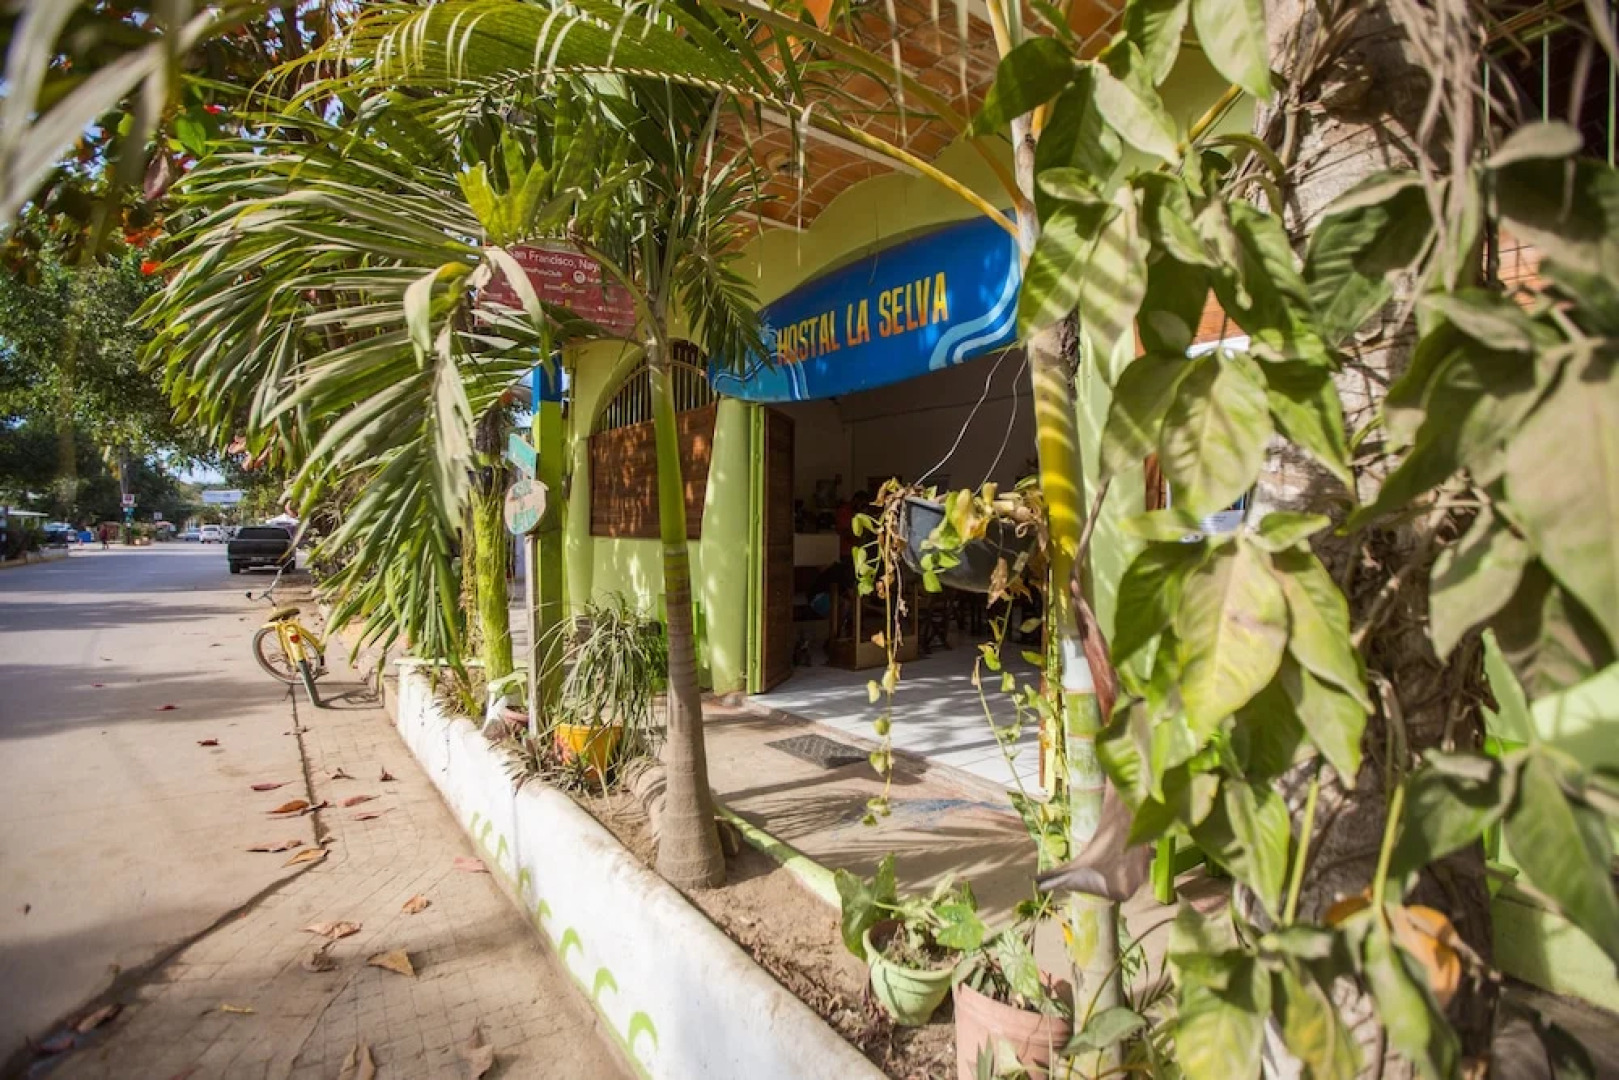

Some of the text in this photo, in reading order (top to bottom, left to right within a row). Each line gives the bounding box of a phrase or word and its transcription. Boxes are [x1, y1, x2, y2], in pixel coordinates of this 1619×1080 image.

[528, 250, 577, 269] Francisco,
[776, 271, 949, 366] HOSTAL LA SELVA
